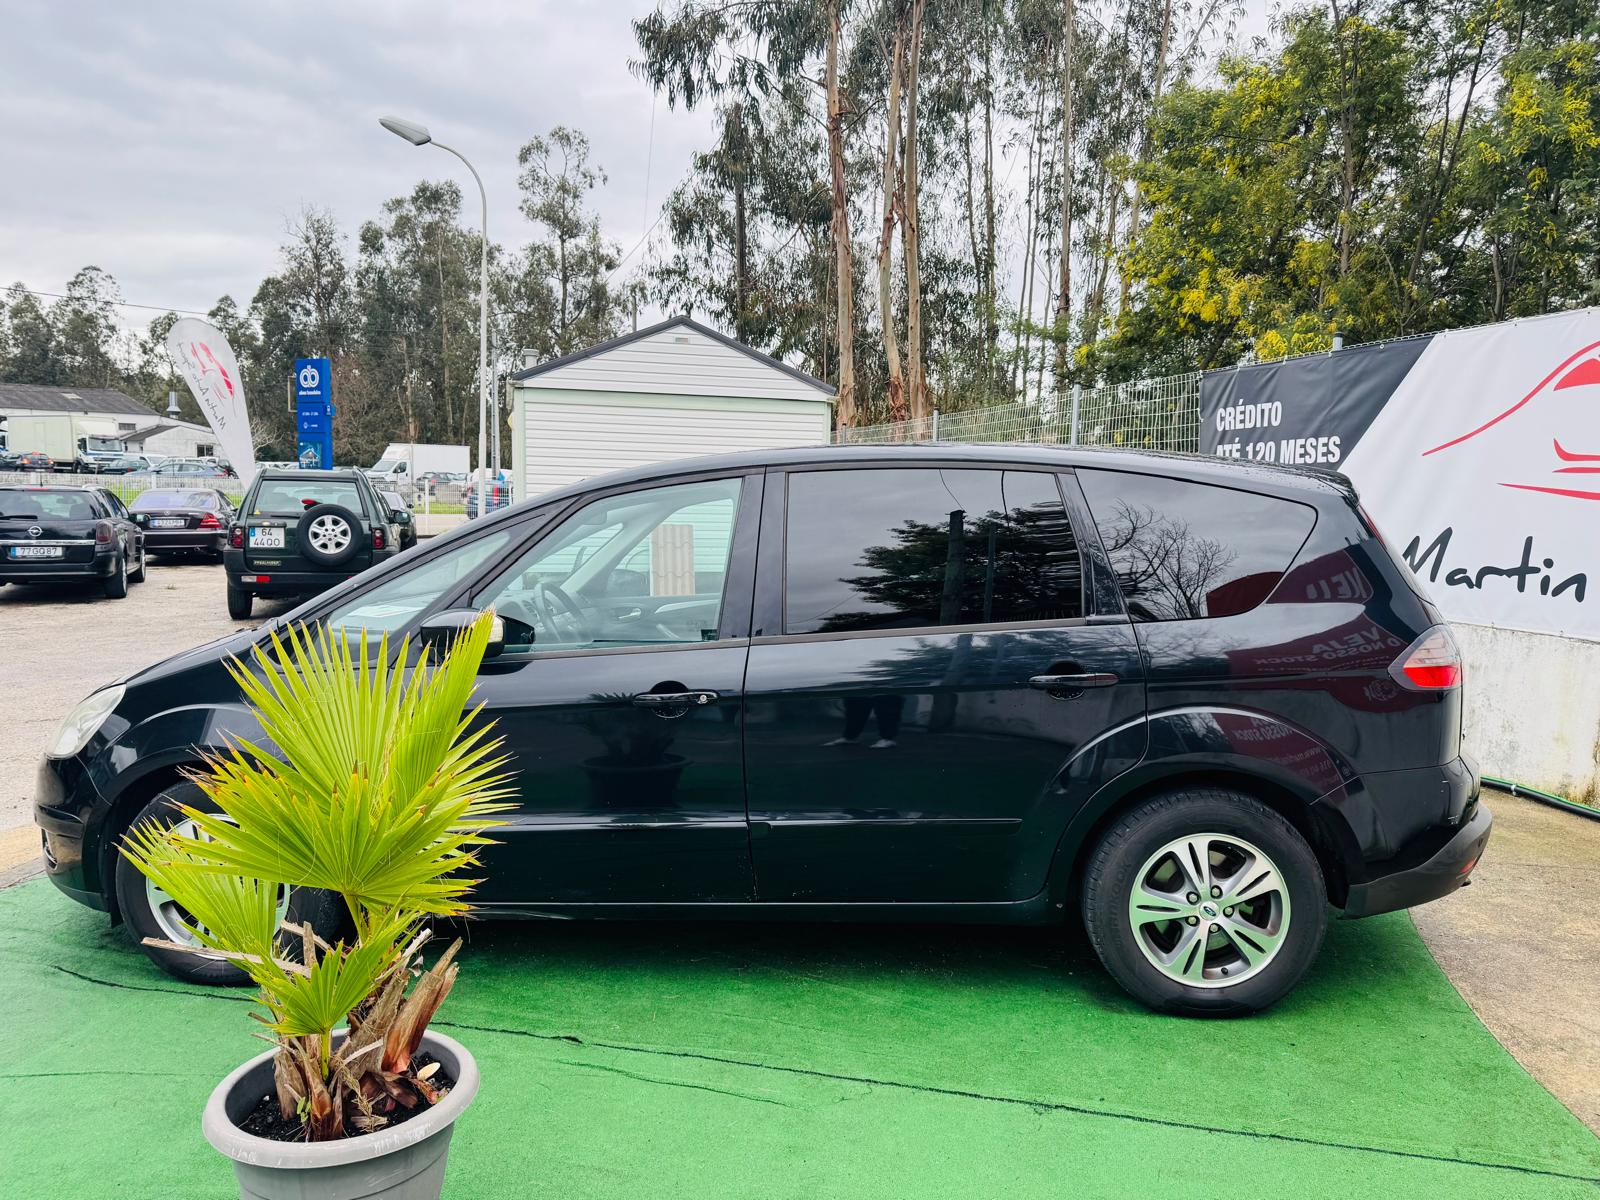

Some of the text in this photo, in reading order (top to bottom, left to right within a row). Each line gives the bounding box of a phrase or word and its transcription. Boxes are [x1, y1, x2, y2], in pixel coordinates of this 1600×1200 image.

[1216, 399, 1282, 431] CRÉDITO
[1245, 440, 1276, 462] 120
[1280, 435, 1341, 465] MESES
[261, 528, 273, 536] 64
[1401, 526, 1587, 603] Martin
